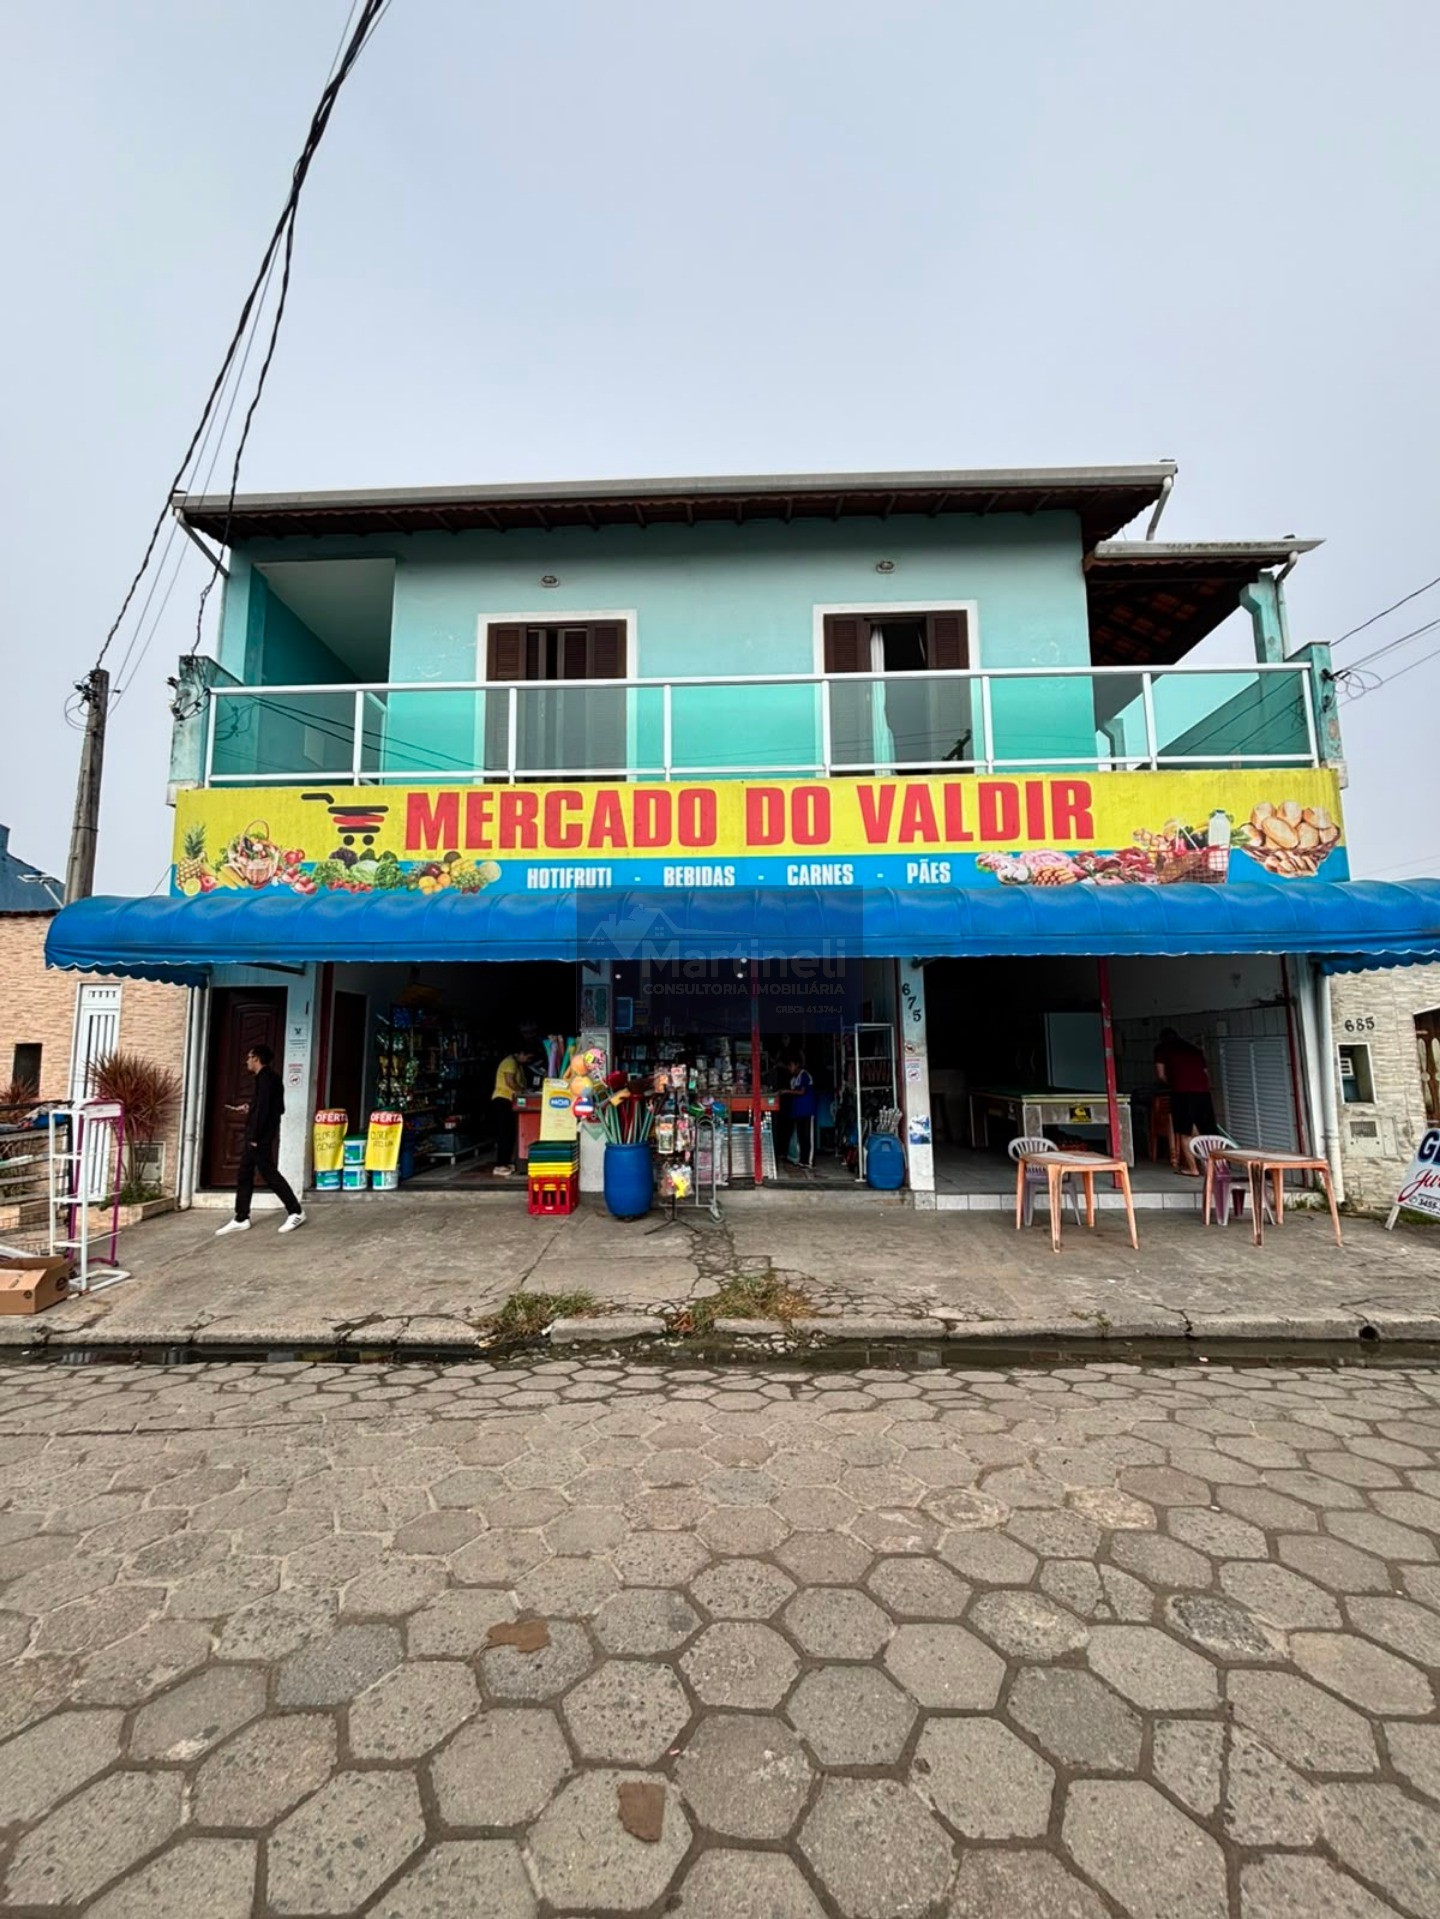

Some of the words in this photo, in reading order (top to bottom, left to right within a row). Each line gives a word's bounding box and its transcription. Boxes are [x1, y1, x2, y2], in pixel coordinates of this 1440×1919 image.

[405, 788, 717, 851] MERCADO
[745, 785, 831, 846] DO
[856, 780, 1095, 844] VALDIR
[527, 867, 612, 889] HOTIFRUTI
[663, 866, 735, 888] BEBIDAS
[787, 864, 854, 886] CARNES
[907, 859, 951, 883] PÃES
[901, 983, 922, 1022] 675
[1344, 1016, 1375, 1032] 685
[370, 1112, 403, 1123] OFERTA
